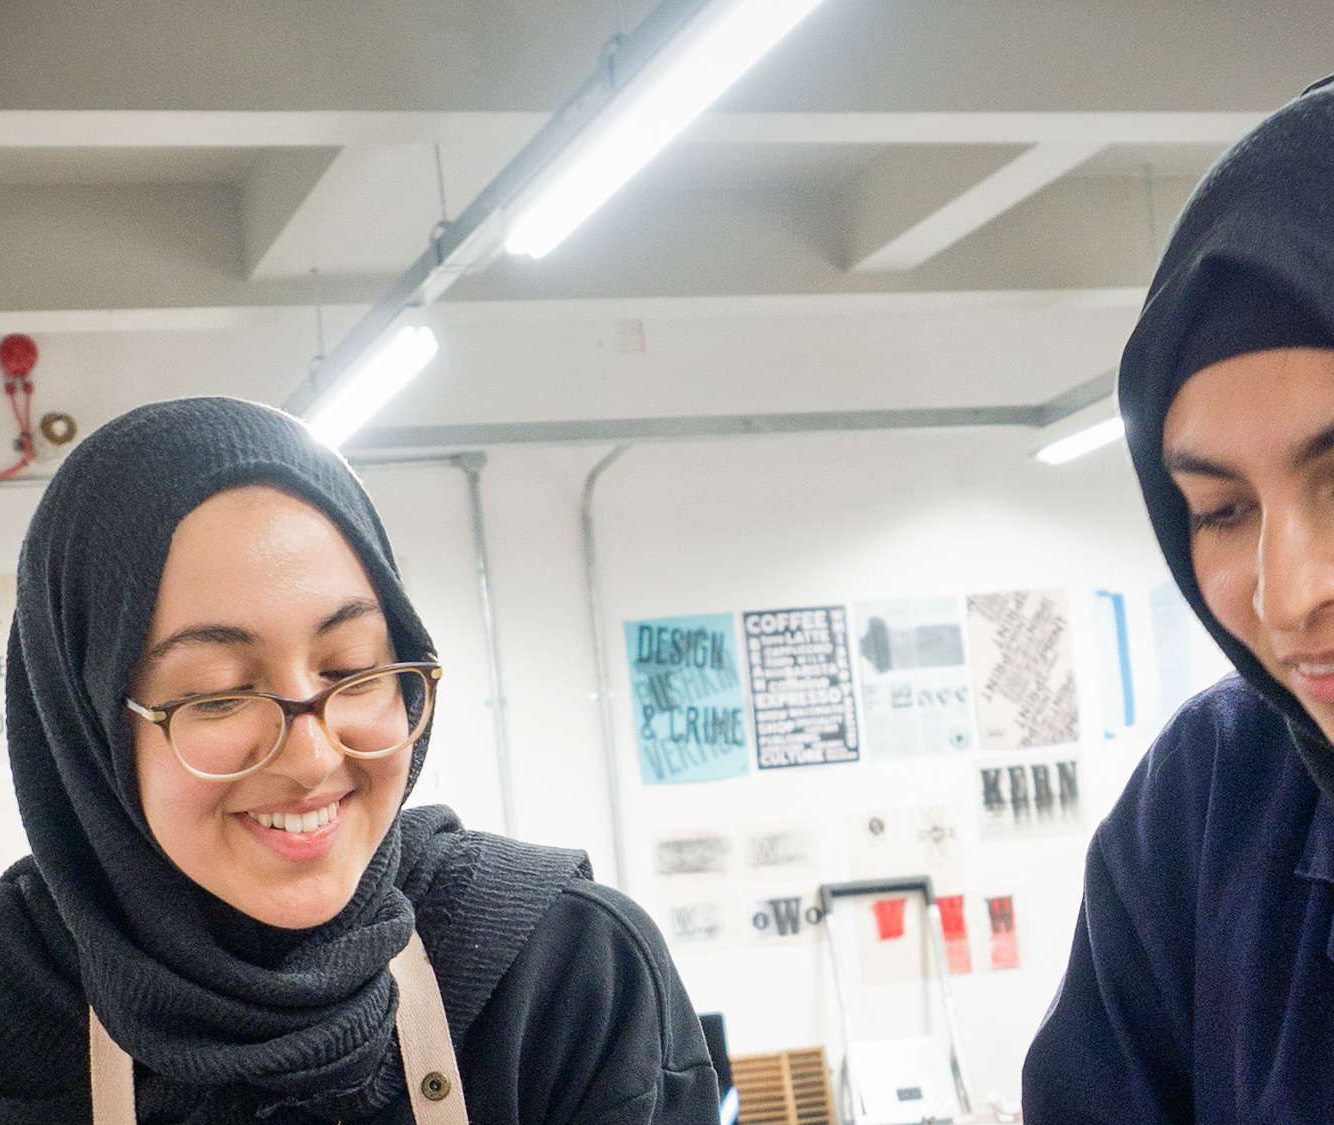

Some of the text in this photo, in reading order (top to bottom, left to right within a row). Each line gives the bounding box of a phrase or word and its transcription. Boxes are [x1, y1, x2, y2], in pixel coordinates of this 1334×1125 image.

[746, 610, 828, 635] COFFEE
[638, 624, 725, 671] DESIGN
[785, 629, 831, 646] LATTE
